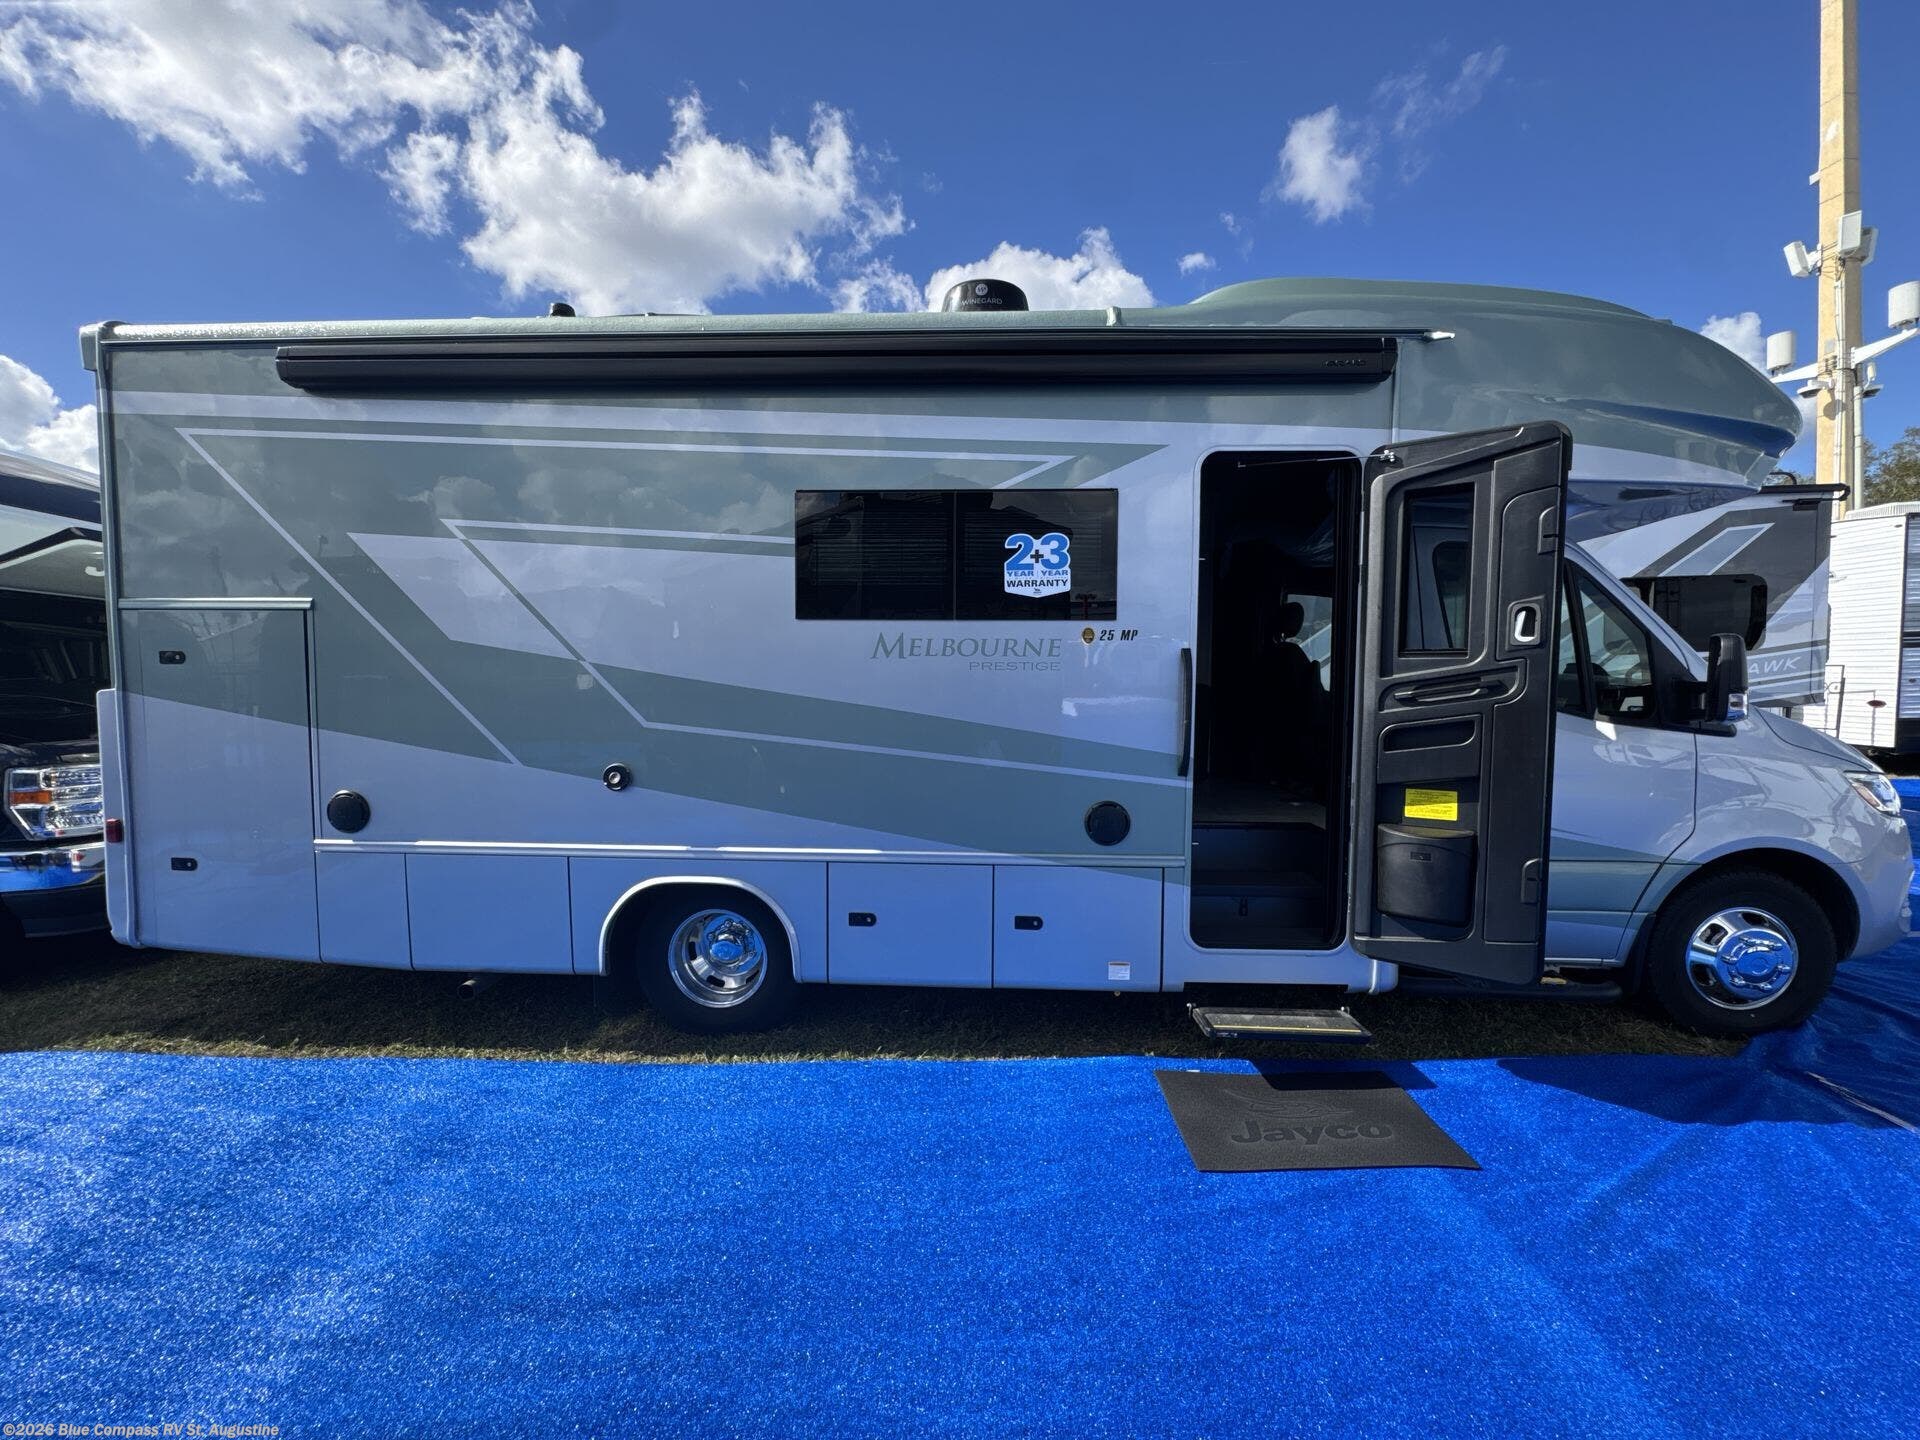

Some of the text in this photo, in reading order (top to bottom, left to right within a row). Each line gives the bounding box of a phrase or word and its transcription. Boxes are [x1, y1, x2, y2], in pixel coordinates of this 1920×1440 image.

[960, 297, 1003, 306] WINEGARD
[1006, 579, 1068, 588] WARRANTY
[1099, 629, 1115, 641] 25
[1120, 629, 1138, 641] MP
[870, 632, 1062, 659] MELBOURNE
[968, 661, 1062, 671] PRESTIGE
[1748, 656, 1801, 674] AWK
[1231, 1120, 1394, 1146] Jayco
